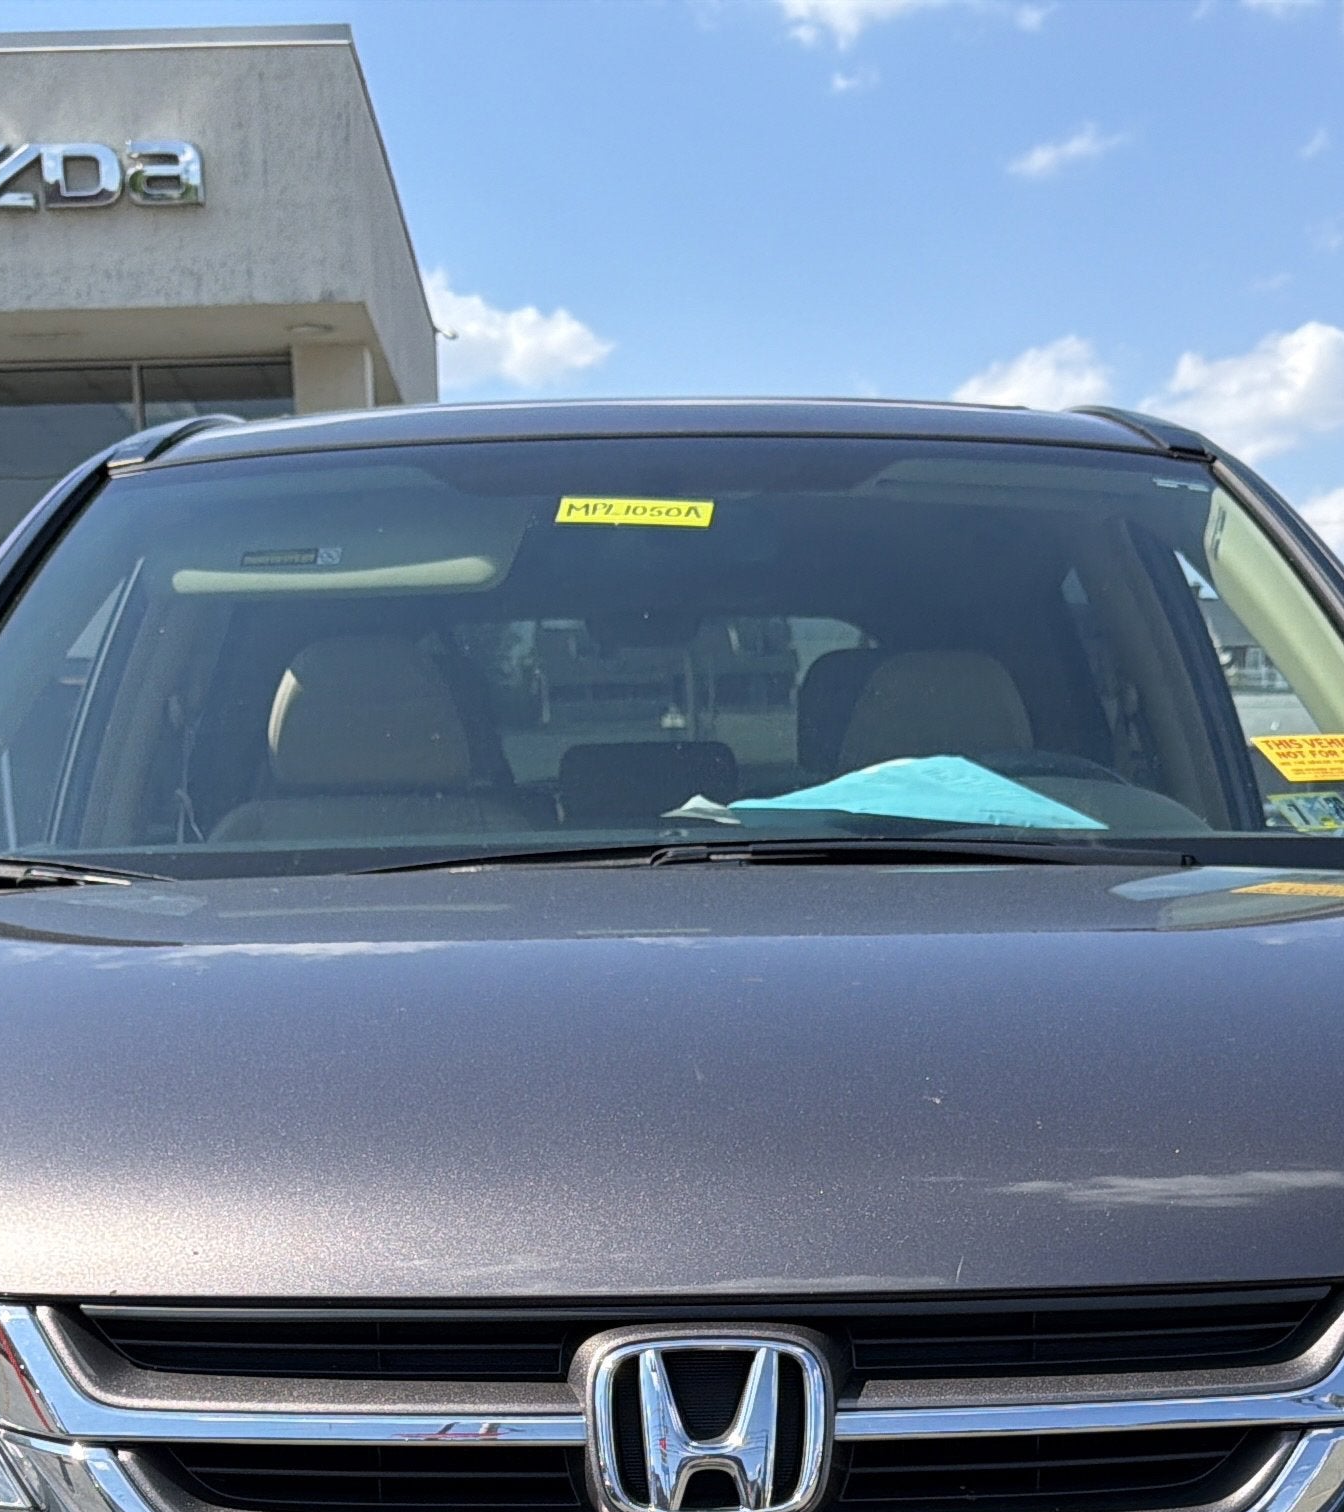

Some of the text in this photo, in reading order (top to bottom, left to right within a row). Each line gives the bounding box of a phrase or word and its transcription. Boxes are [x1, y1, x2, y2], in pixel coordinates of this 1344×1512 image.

[1261, 739, 1303, 750] THIS
[1275, 751, 1307, 760] NOT
[1310, 750, 1340, 759] FOR
